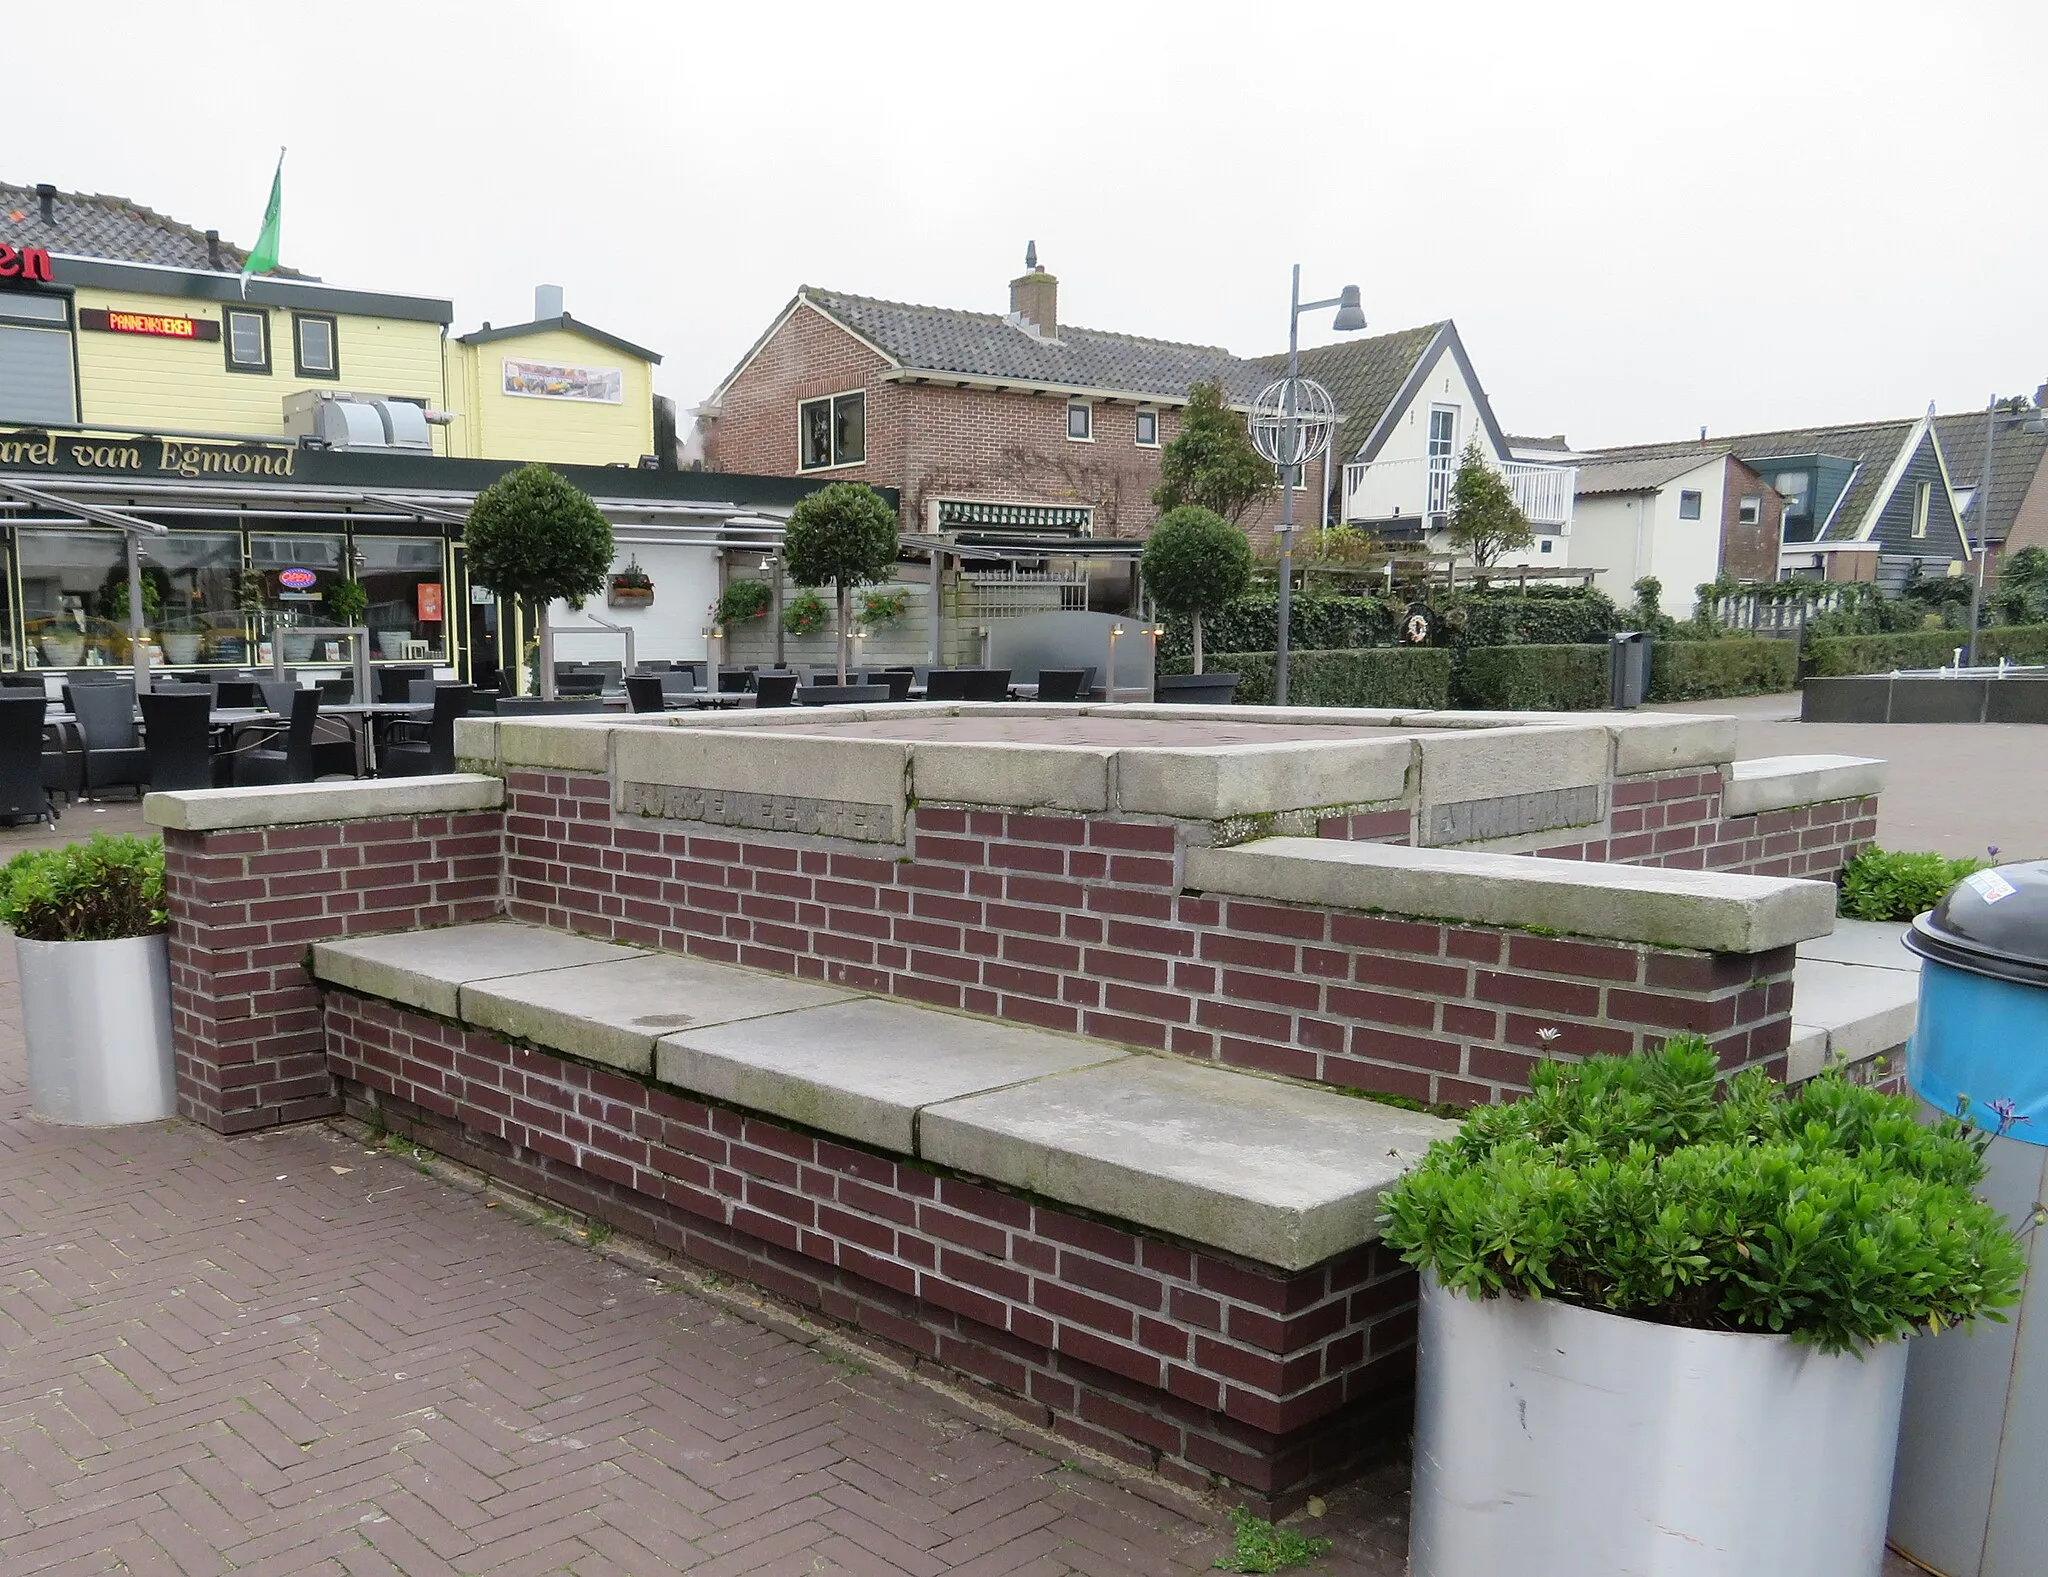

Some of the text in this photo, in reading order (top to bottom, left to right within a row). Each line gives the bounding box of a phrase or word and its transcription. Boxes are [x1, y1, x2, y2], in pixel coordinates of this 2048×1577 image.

[109, 312, 194, 337] PANNENKOEKEN
[71, 446, 141, 469] van
[158, 440, 295, 478] Egmond
[281, 571, 314, 583] OPEN
